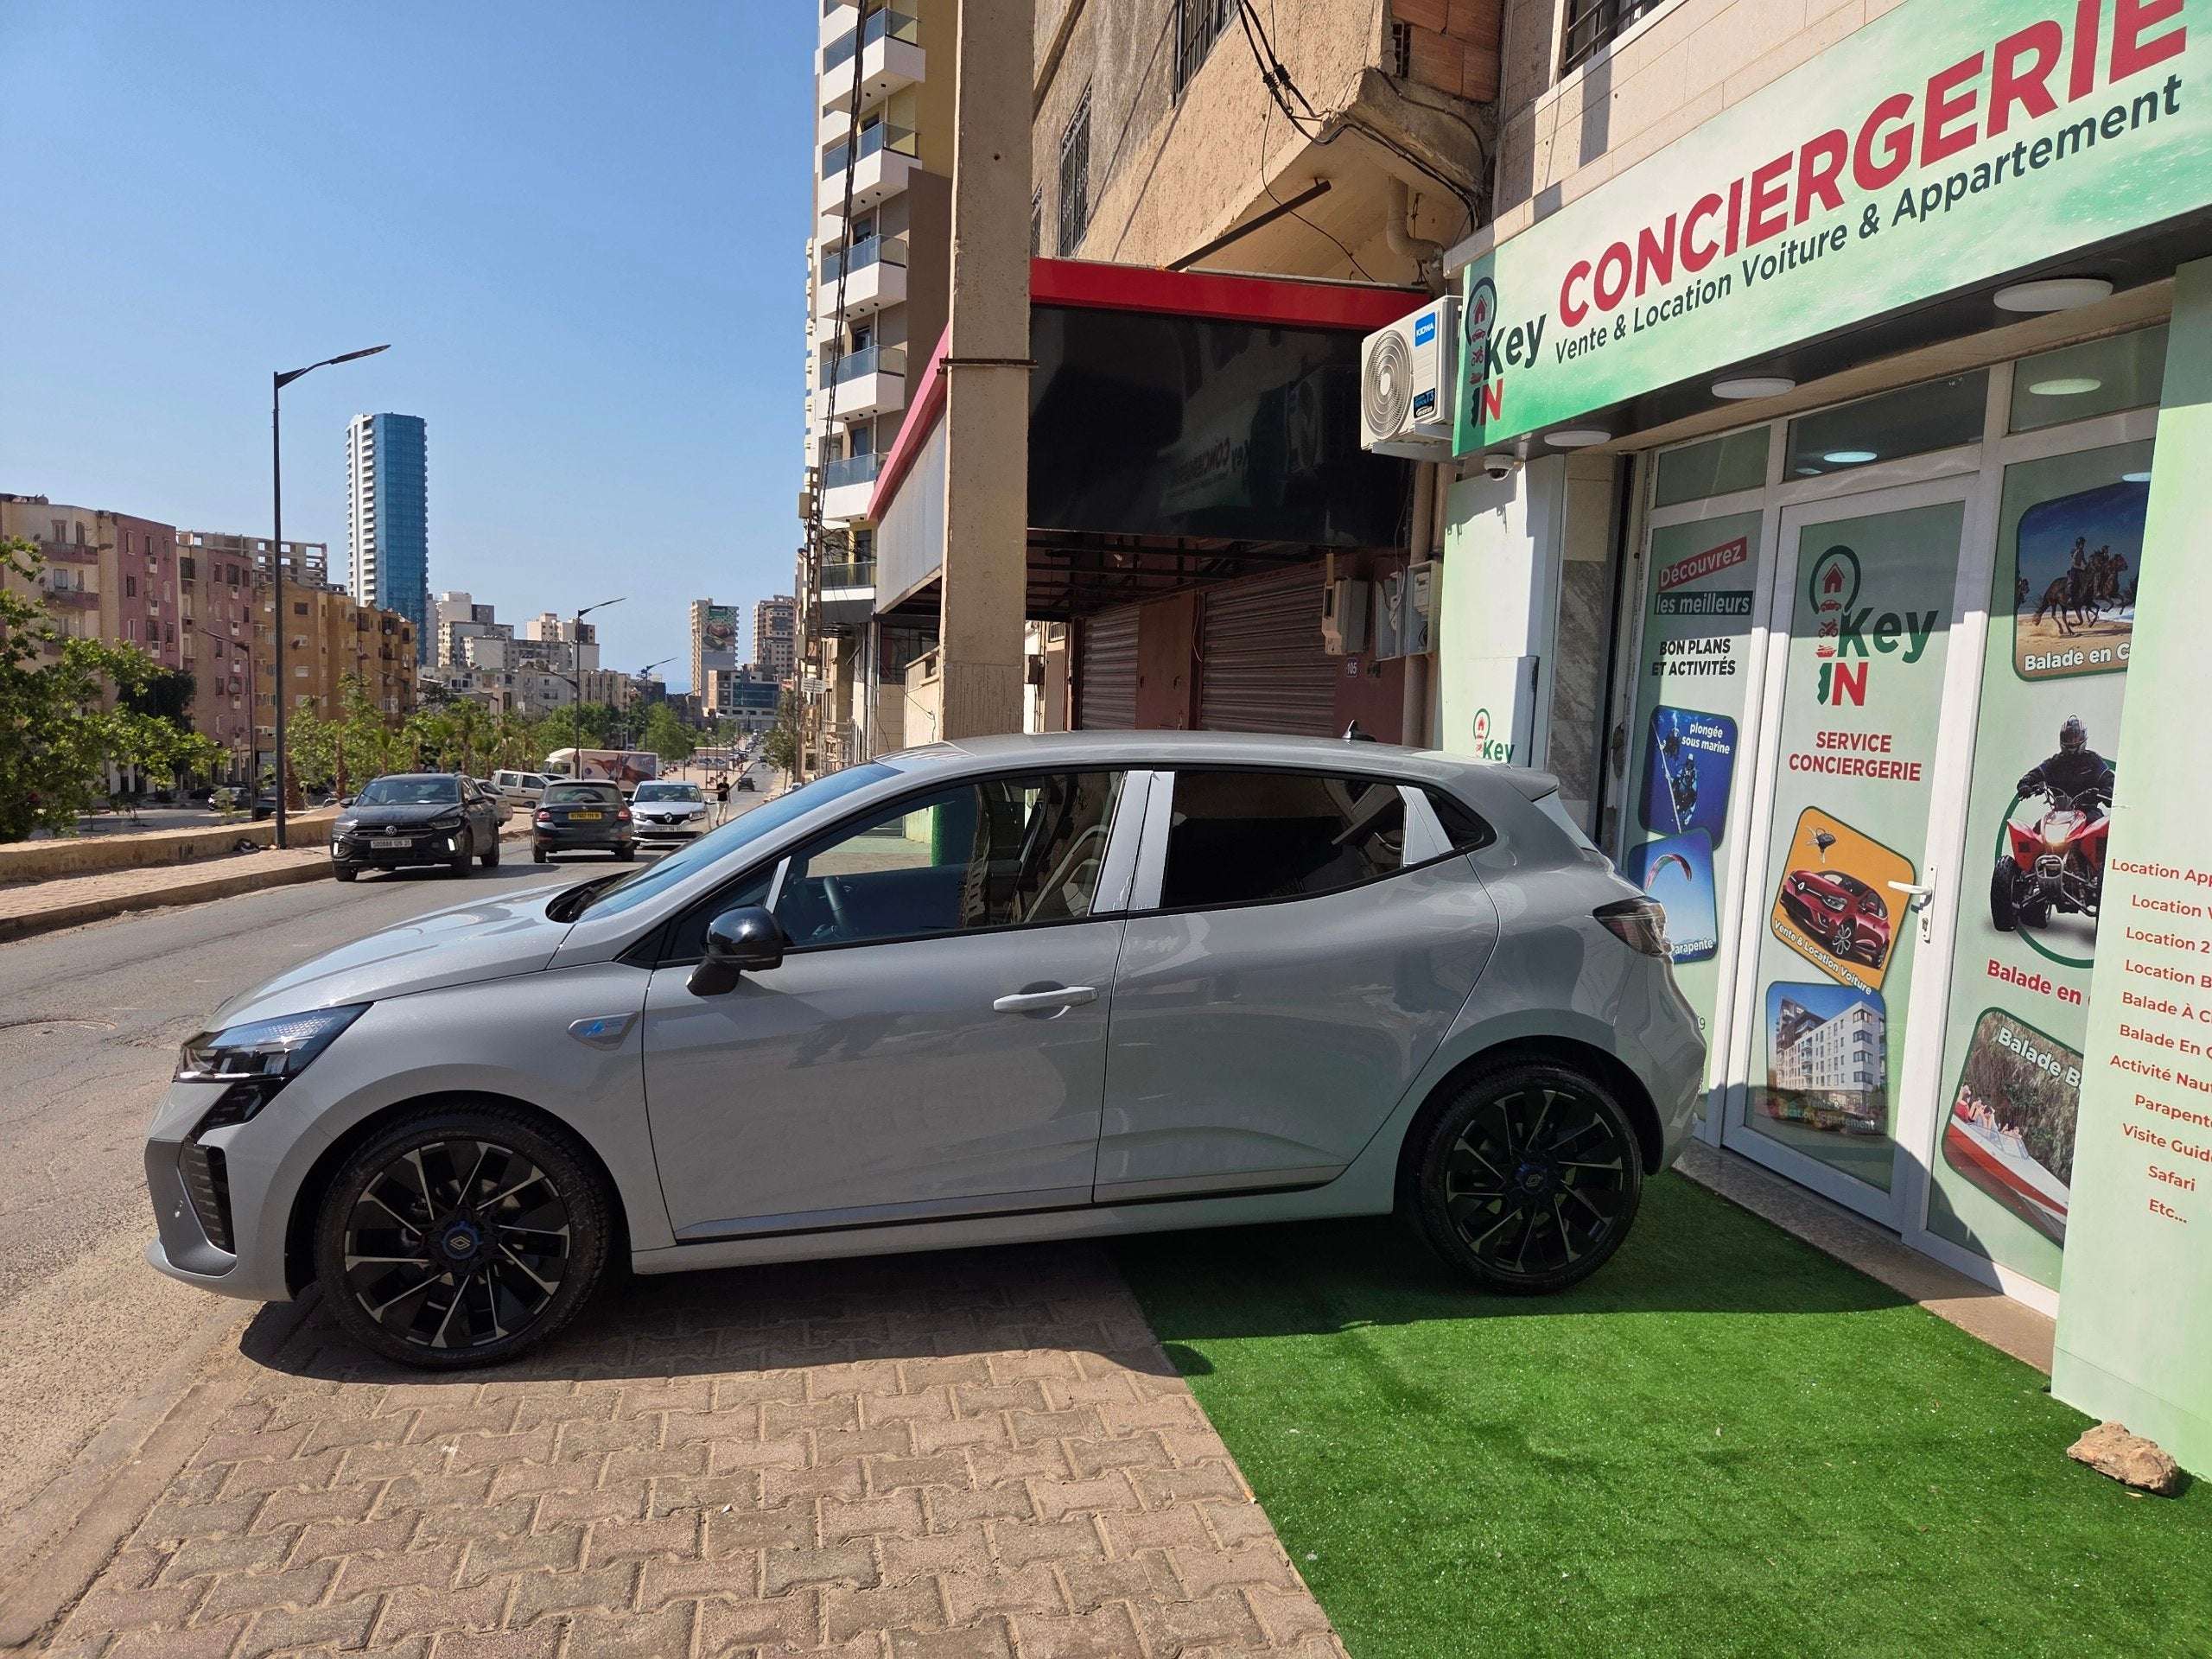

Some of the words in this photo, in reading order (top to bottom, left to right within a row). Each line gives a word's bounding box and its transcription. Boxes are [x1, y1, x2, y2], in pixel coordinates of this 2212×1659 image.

[1560, 0, 2187, 327] CONCIERGERIE
[1555, 327, 1607, 365] Vente
[1614, 315, 1626, 341] &
[1634, 274, 1732, 334] Location
[1743, 223, 1847, 289] Voiture
[1859, 203, 1880, 239] &
[1891, 73, 2183, 227] Appartement
[1483, 313, 1547, 381] Key
[1661, 544, 1742, 588] Découvrez
[1656, 594, 1675, 613] les
[1679, 592, 1750, 613] meilleurs
[1660, 639, 1685, 655] BON
[1688, 639, 1731, 655] PLANS
[1837, 607, 1939, 664] Key
[1652, 661, 1666, 676] ET
[1669, 656, 1736, 676] ACTIVITÉS
[2024, 649, 2084, 671] Balade
[2088, 648, 2112, 664] en
[1689, 721, 1723, 739] plongée
[1815, 731, 1892, 753] SERVICE
[1482, 739, 1516, 764] Key
[1681, 736, 1700, 748] sous
[1700, 741, 1730, 754] marine
[1789, 753, 1923, 781] CONCIERGERIE
[2112, 858, 2179, 879] Location
[2133, 894, 2202, 918] Location
[2126, 926, 2196, 950] Location
[2200, 941, 2210, 954] 2
[1775, 918, 1796, 940] Vente
[1796, 938, 1804, 947] &
[1804, 941, 1839, 972] Location
[1840, 965, 1872, 995] Voiture
[1987, 959, 2052, 995] Balade
[2057, 986, 2082, 1005] en
[2125, 959, 2195, 985] Location
[2122, 991, 2177, 1015] Balade
[2181, 1002, 2194, 1020] À
[1998, 1027, 2062, 1077] Balade
[2120, 1024, 2175, 1048] Balade
[2179, 1039, 2201, 1055] En
[2110, 1054, 2171, 1081] Activité
[2123, 1122, 2166, 1147] Visite
[2148, 1165, 2196, 1192] Safari
